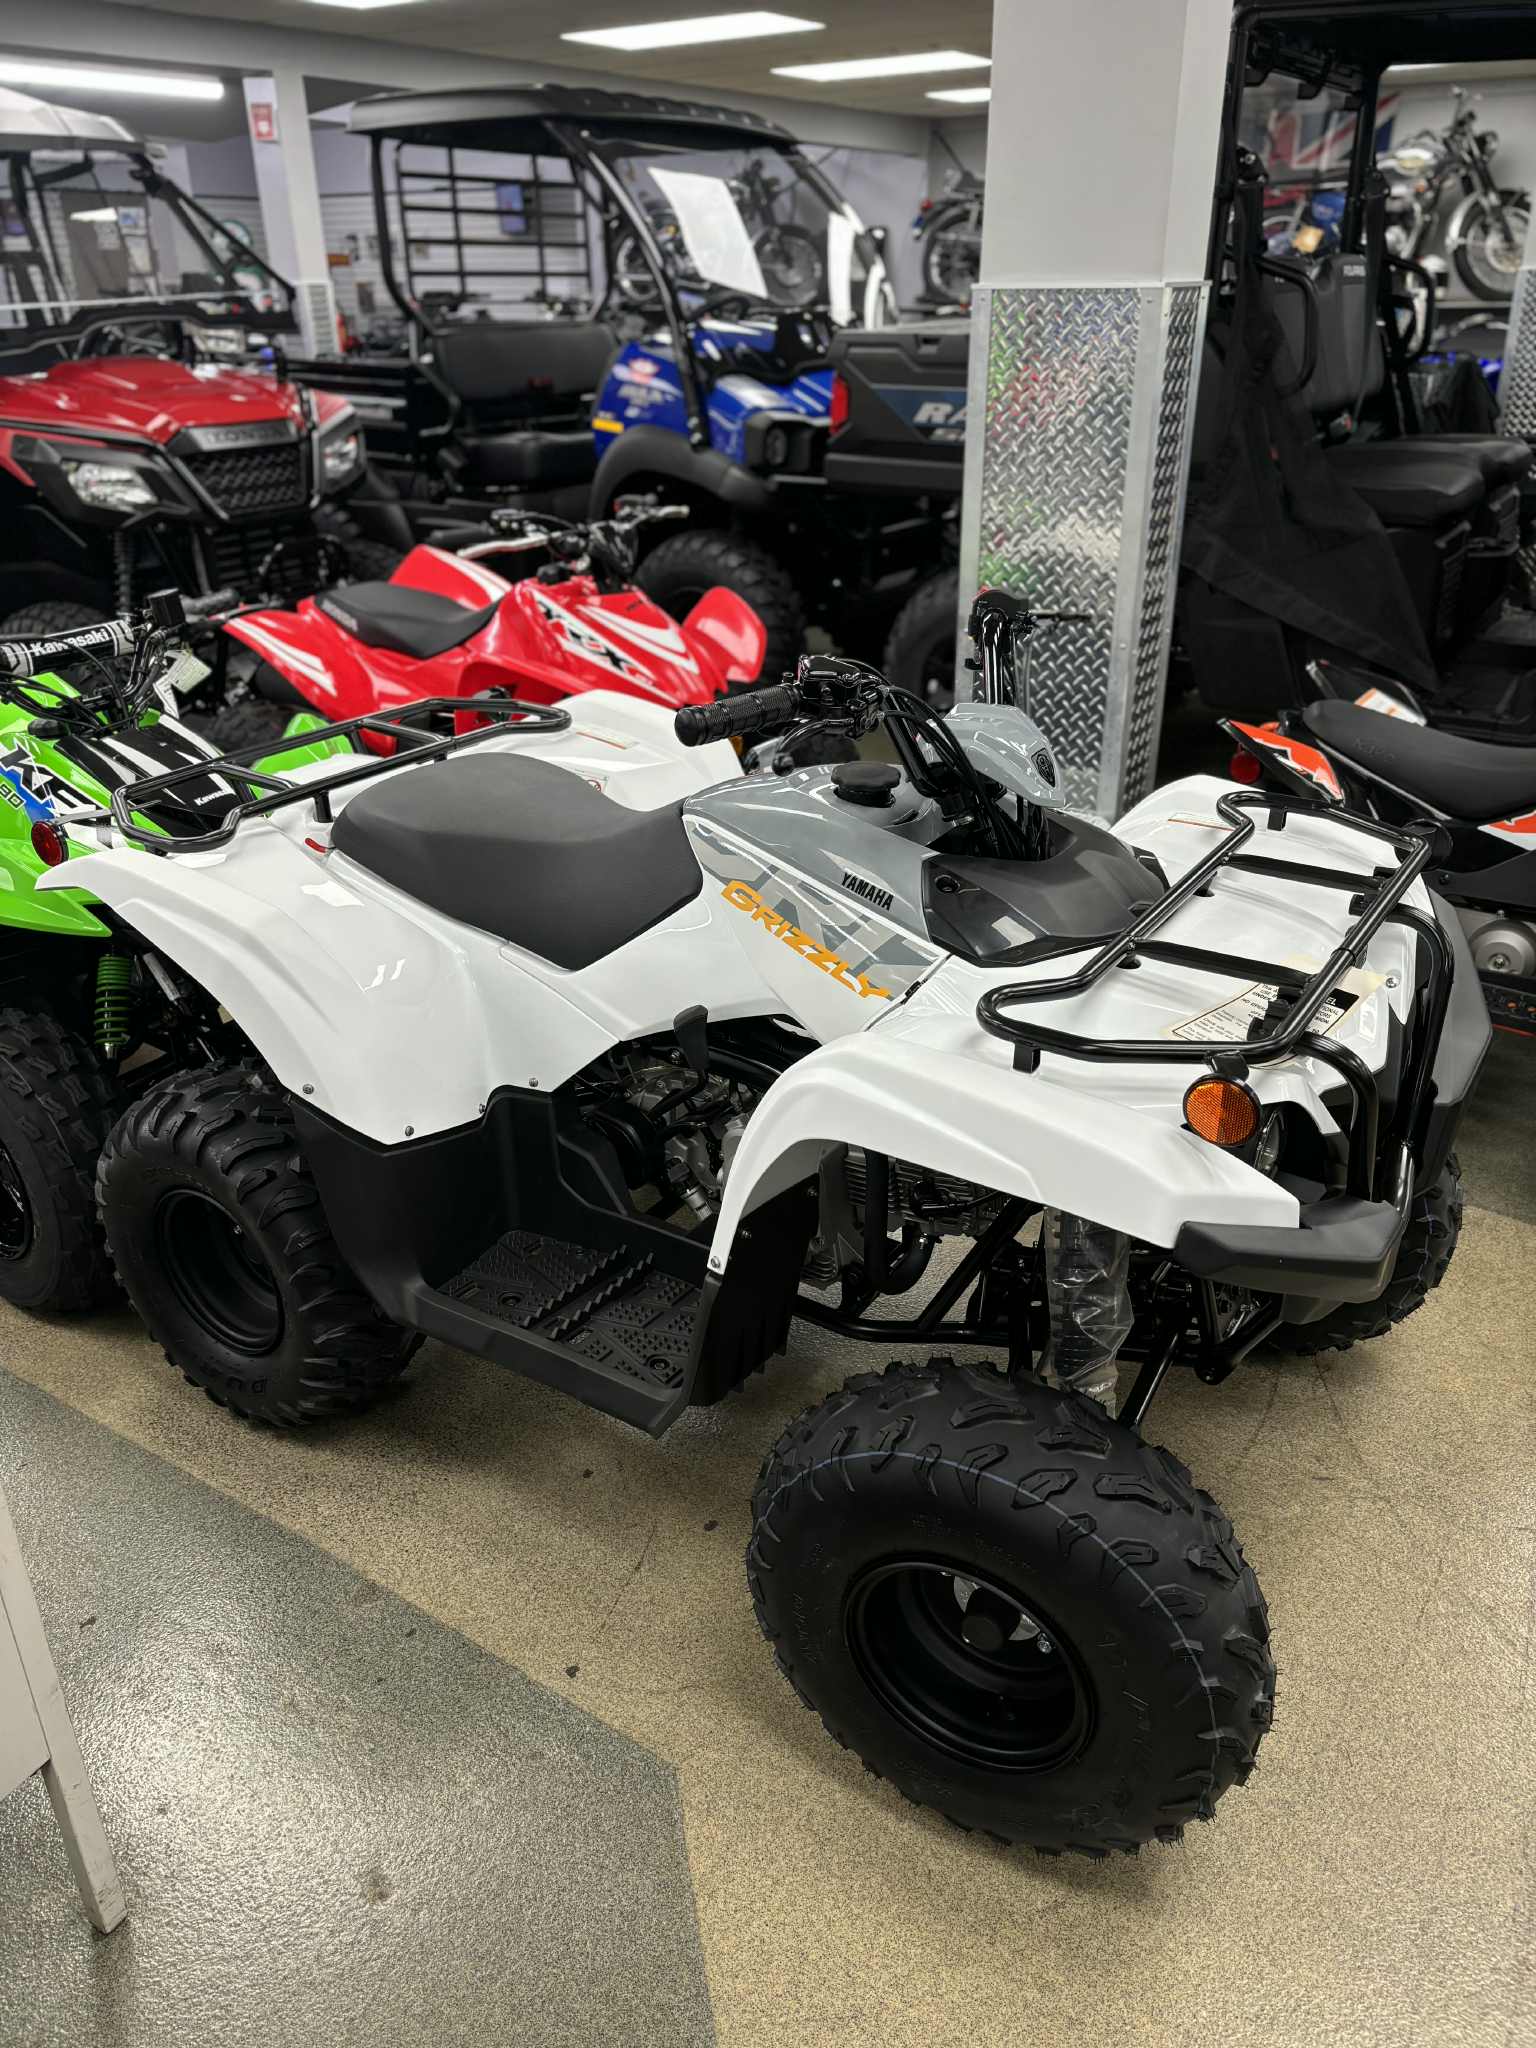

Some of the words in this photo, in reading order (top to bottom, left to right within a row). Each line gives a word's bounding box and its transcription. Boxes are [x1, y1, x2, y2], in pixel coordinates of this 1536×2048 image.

[30, 627, 112, 657] Kawasaki
[840, 871, 894, 912] YAMAHA
[721, 880, 893, 998] GRIZZLY
